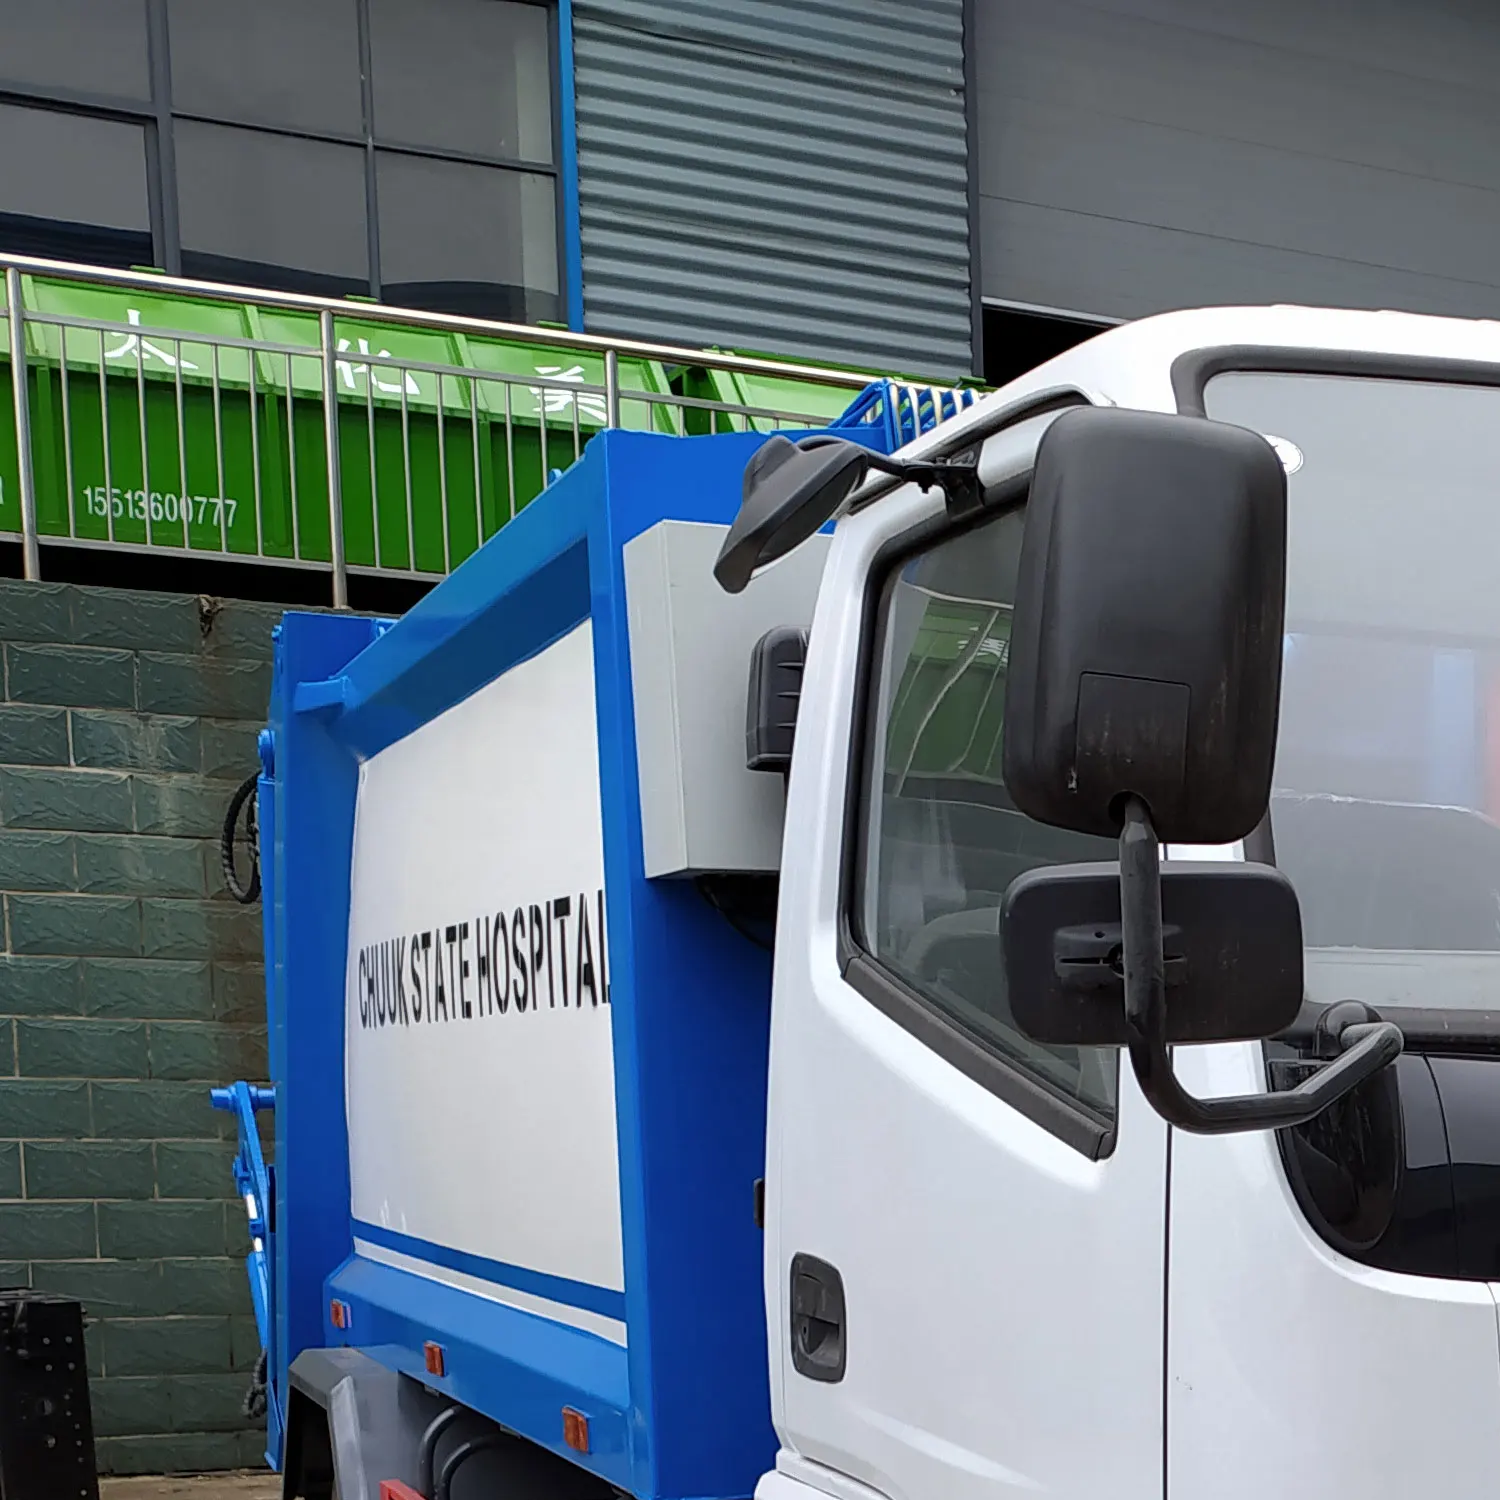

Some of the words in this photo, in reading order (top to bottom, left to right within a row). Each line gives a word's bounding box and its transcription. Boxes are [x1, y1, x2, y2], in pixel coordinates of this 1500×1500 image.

[83, 485, 238, 528] 15513600777
[358, 936, 410, 1029] CHUUK
[411, 922, 473, 1024] STATE
[476, 889, 611, 1018] HOSPITAL
